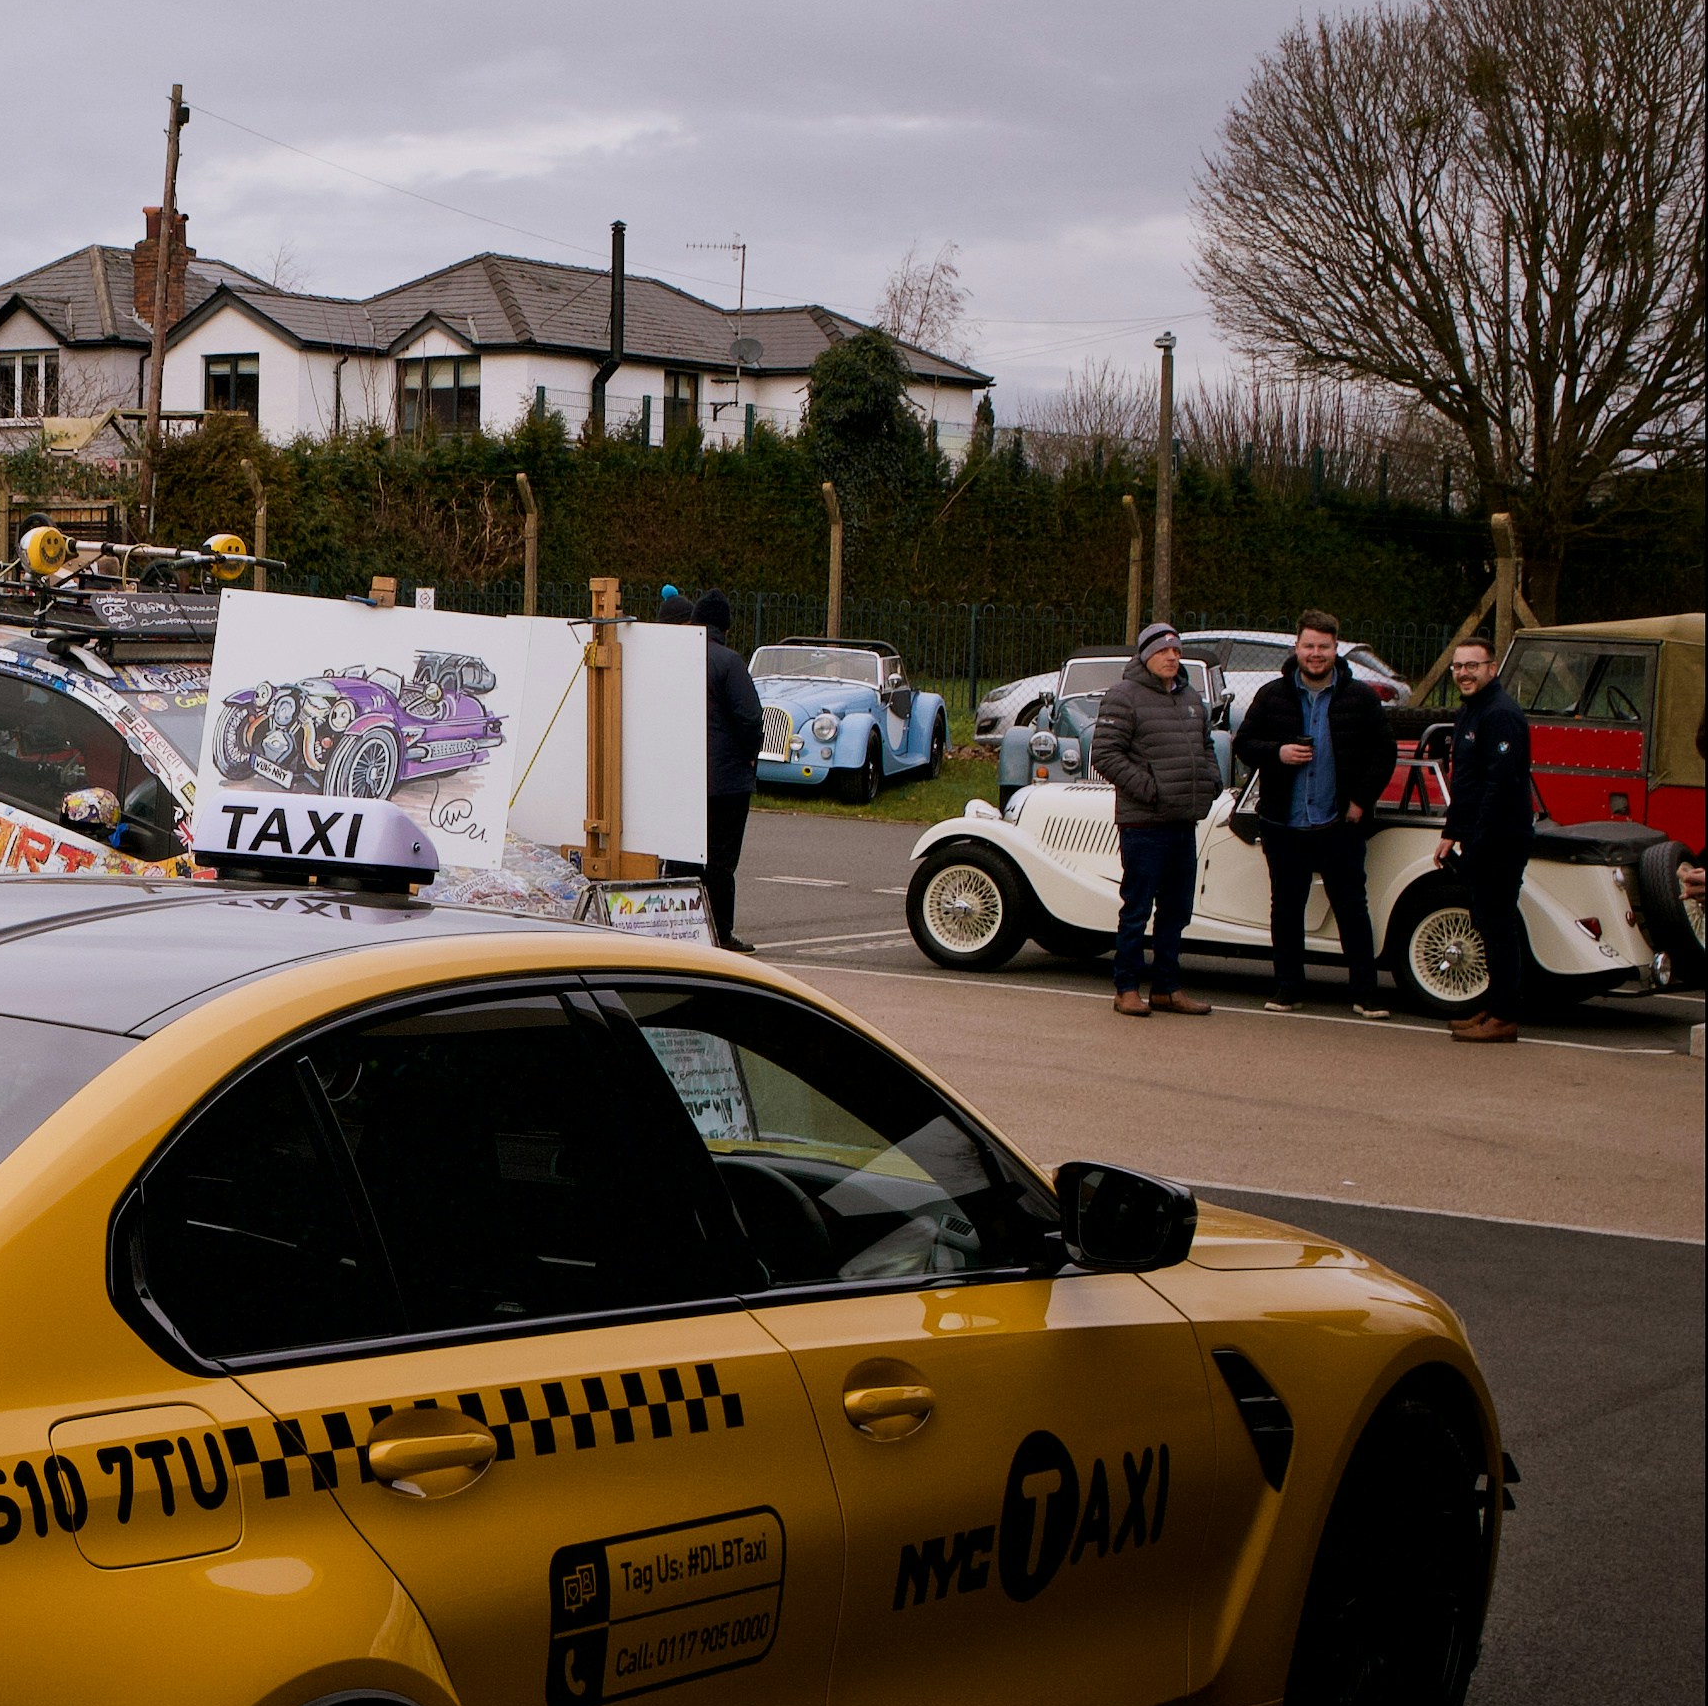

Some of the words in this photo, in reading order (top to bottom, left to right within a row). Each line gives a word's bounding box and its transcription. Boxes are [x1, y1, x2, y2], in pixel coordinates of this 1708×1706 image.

[222, 804, 364, 858] TAXI
[96, 1431, 229, 1524] 7TU
[892, 1524, 995, 1612] NYC
[1017, 1442, 1170, 1577] TAXI
[620, 1561, 653, 1594] Tag
[656, 1553, 684, 1584] Us:
[687, 1532, 767, 1578] #DLBTaxi
[615, 1641, 654, 1678] Call:
[656, 1630, 698, 1666] 0117
[700, 1621, 730, 1656] 905
[730, 1612, 770, 1648] 0000
